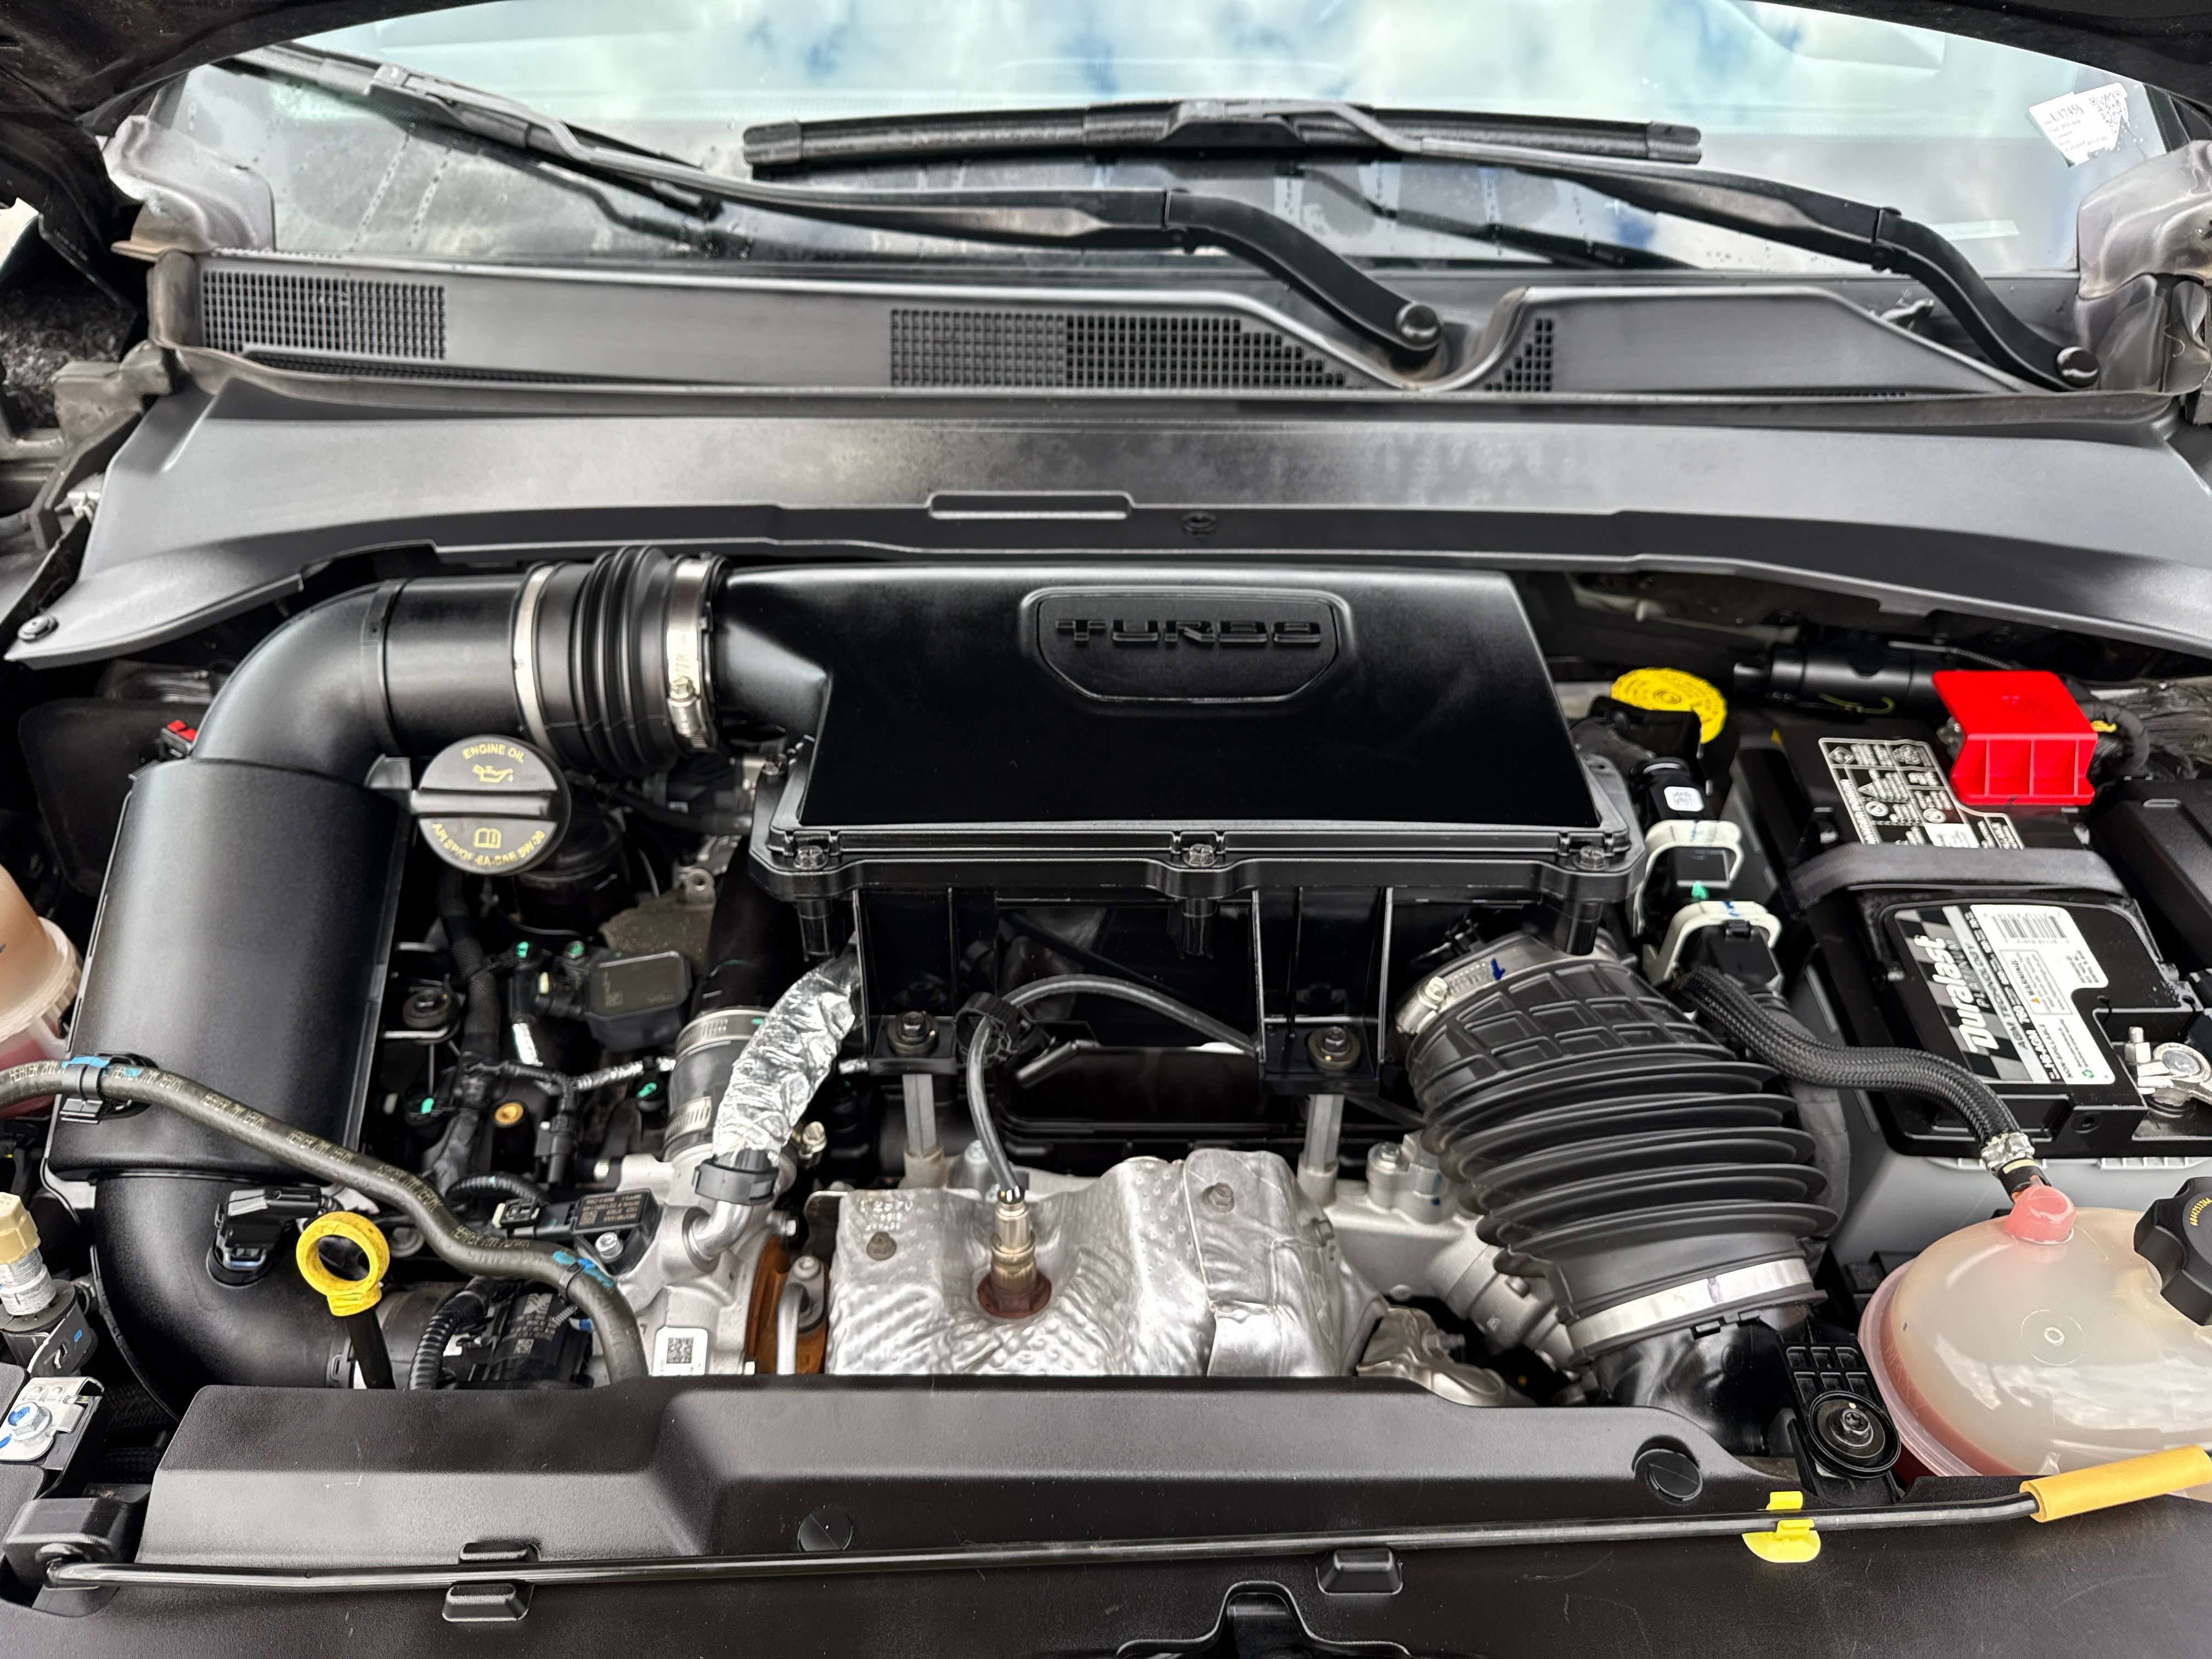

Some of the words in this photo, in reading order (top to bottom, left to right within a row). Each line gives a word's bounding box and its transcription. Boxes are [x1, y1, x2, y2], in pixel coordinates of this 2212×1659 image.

[1056, 619, 1321, 643] TURBO
[462, 743, 506, 759] ENGINE
[508, 747, 524, 763] OIL
[432, 823, 448, 842] API
[1965, 941, 2011, 1019] TECHNOLOGY
[1914, 935, 2000, 1053] Duralast
[2006, 1021, 2029, 1051] AGM
